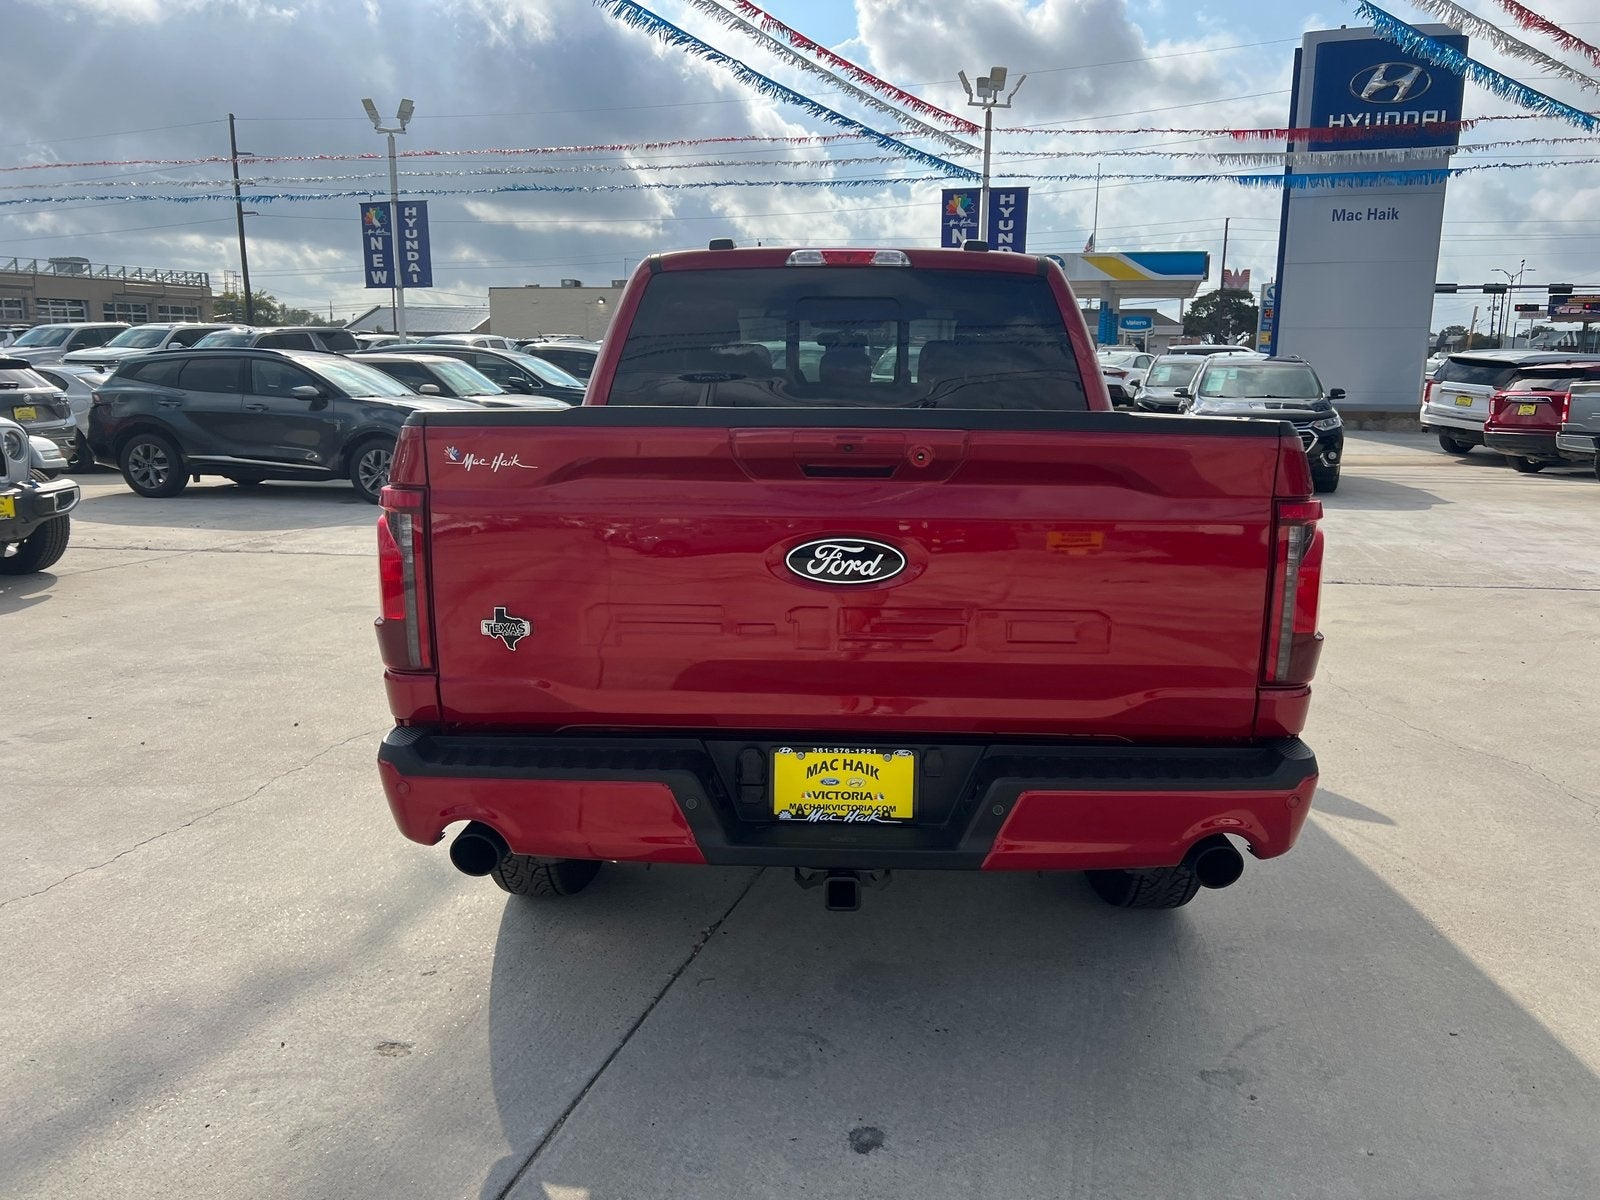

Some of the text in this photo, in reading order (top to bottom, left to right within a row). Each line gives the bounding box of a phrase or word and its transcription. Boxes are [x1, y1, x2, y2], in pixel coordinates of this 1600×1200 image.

[1328, 109, 1447, 129] HYUNDAI
[997, 194, 1016, 252] HYUND
[1332, 207, 1400, 221] Mac Haik
[404, 207, 421, 283] HYUNDAI
[370, 237, 388, 284] NEW
[462, 453, 538, 473] Mac Haik
[806, 544, 884, 576] Ford
[484, 622, 526, 633] TEXAS
[806, 758, 880, 780] MAC HAIK
[812, 791, 873, 801] VICTORIA
[806, 808, 842, 822] Mac
